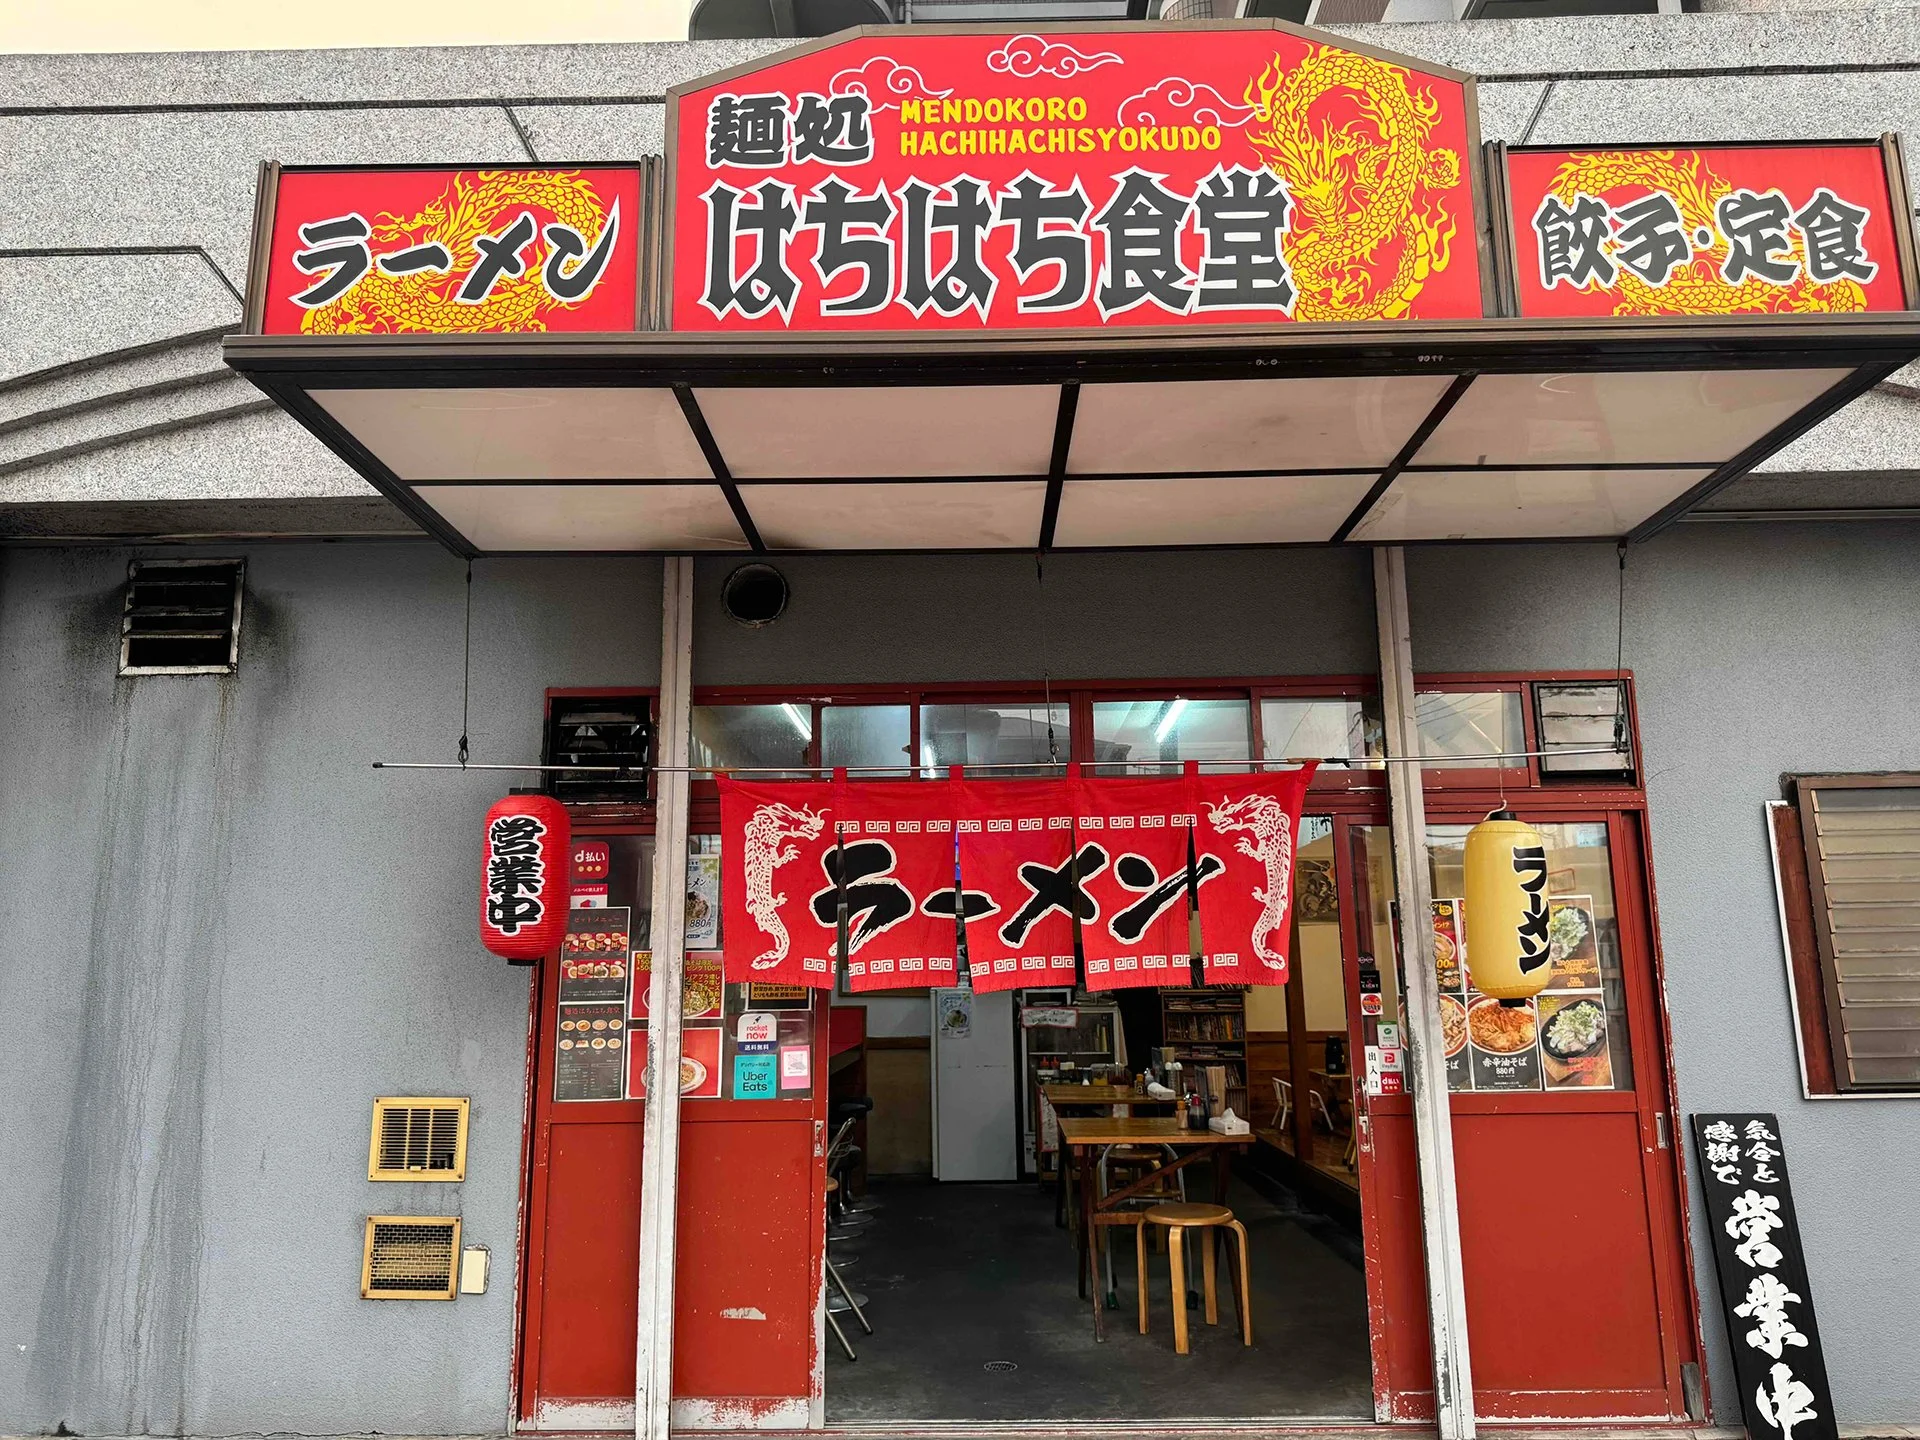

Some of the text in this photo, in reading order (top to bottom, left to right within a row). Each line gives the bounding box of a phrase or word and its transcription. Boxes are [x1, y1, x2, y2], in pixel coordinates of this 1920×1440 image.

[709, 94, 871, 167] 麺処
[900, 96, 1088, 125] MENDOKORO
[900, 125, 1222, 157] HACHIHACHISYOKUDO
[291, 198, 619, 308] ラーメン
[701, 164, 1298, 323] はちはち食堂
[488, 816, 546, 935] 営業中
[574, 849, 606, 863] d払い
[810, 840, 1225, 957] ラーメン
[1512, 845, 1551, 976] ラーメン
[746, 1032, 768, 1040] now
[743, 1071, 768, 1081] Uber
[743, 1082, 768, 1092] Eats
[1368, 1051, 1379, 1089] 出入口
[1703, 1120, 1742, 1186] 感謝で
[1743, 1119, 1781, 1184] 気合と
[1724, 1188, 1818, 1439] 営業中
